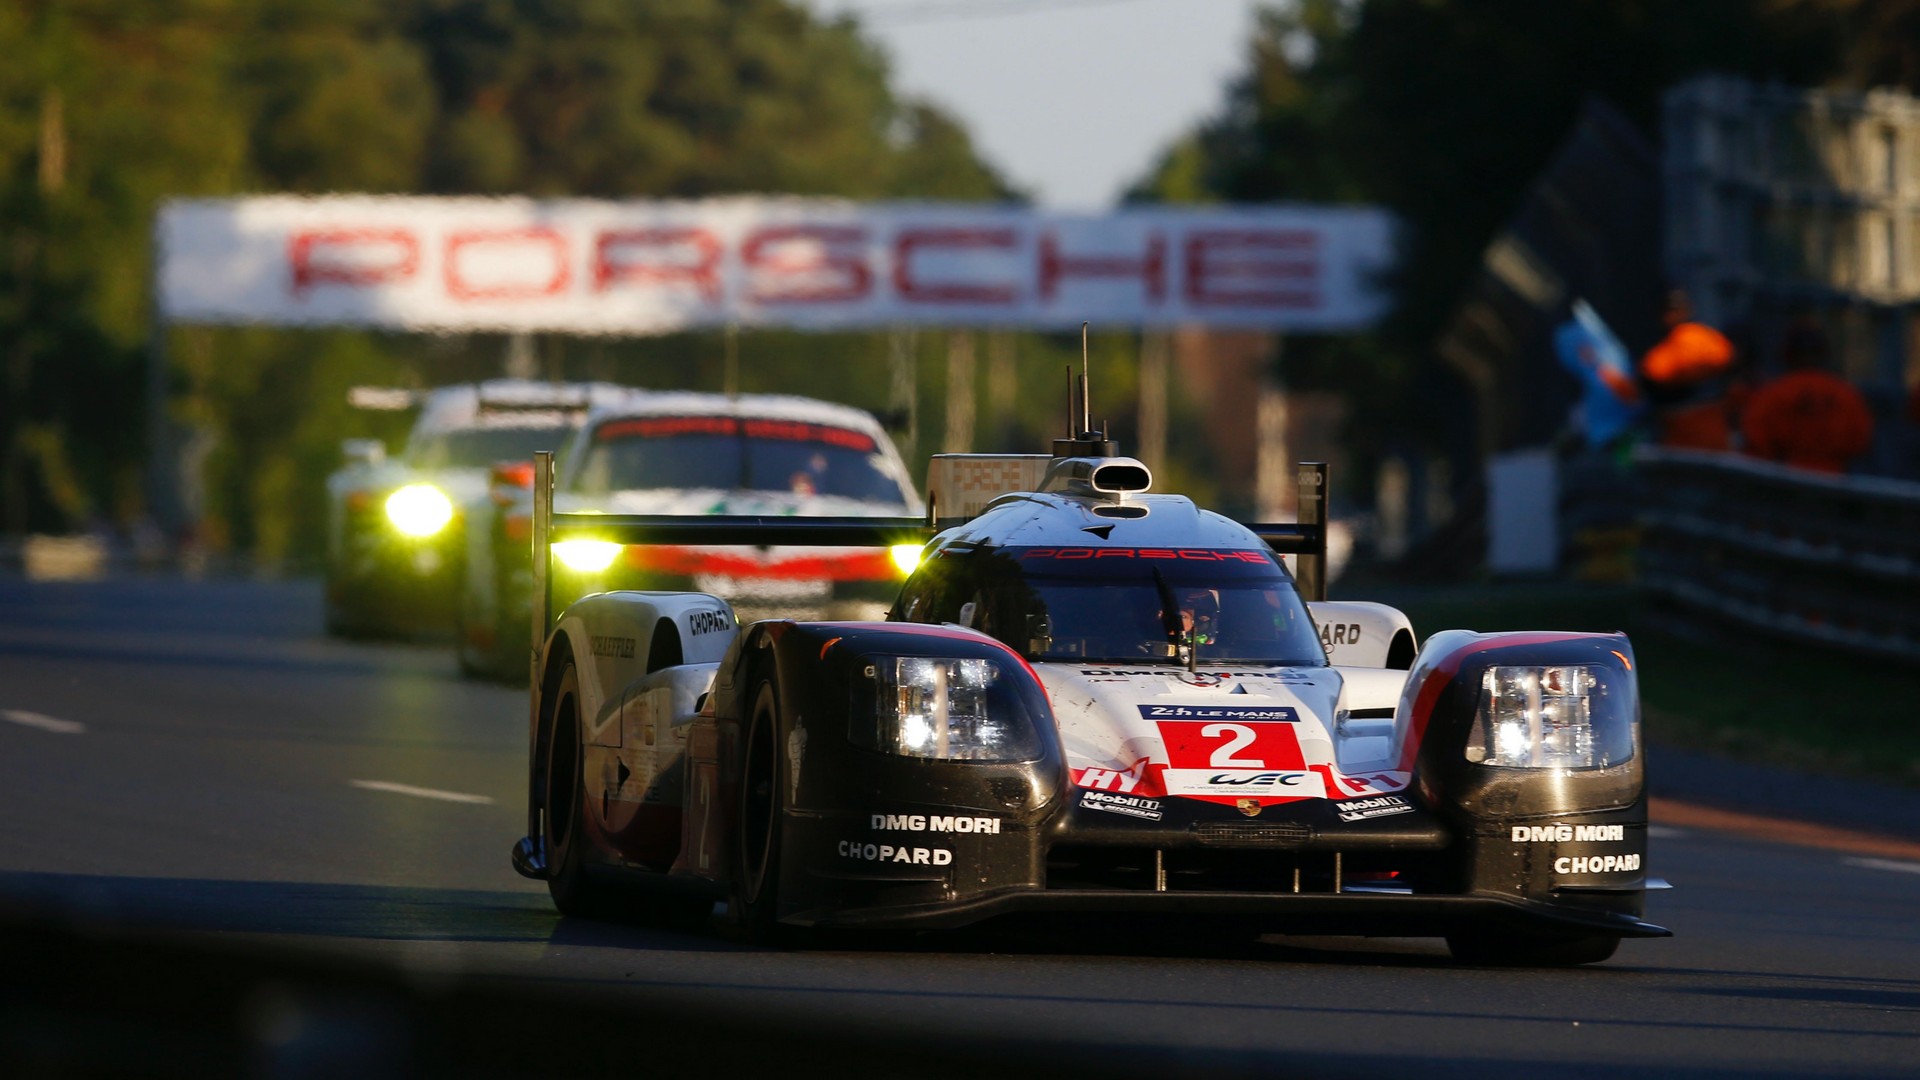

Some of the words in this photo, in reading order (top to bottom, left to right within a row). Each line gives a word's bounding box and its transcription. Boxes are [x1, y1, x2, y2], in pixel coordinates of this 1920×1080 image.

[286, 226, 1322, 306] PORSCHE
[953, 461, 1020, 490] PORSCHE
[1022, 548, 1269, 564] PORSCHE
[690, 609, 730, 636] CHOPARD
[1201, 723, 1265, 768] 2
[1077, 759, 1148, 793] HY
[1209, 773, 1305, 786] WEC
[1341, 774, 1403, 793] P1
[1083, 791, 1140, 807] Mobil
[1336, 797, 1391, 812] Mobil
[700, 771, 710, 869] 2
[871, 814, 926, 831] DMG
[930, 815, 1001, 834] MORI
[1511, 825, 1574, 842] DMG
[1575, 825, 1624, 841] MORI
[838, 840, 953, 866] CHOPARD
[1554, 853, 1641, 874] CHOPARD
